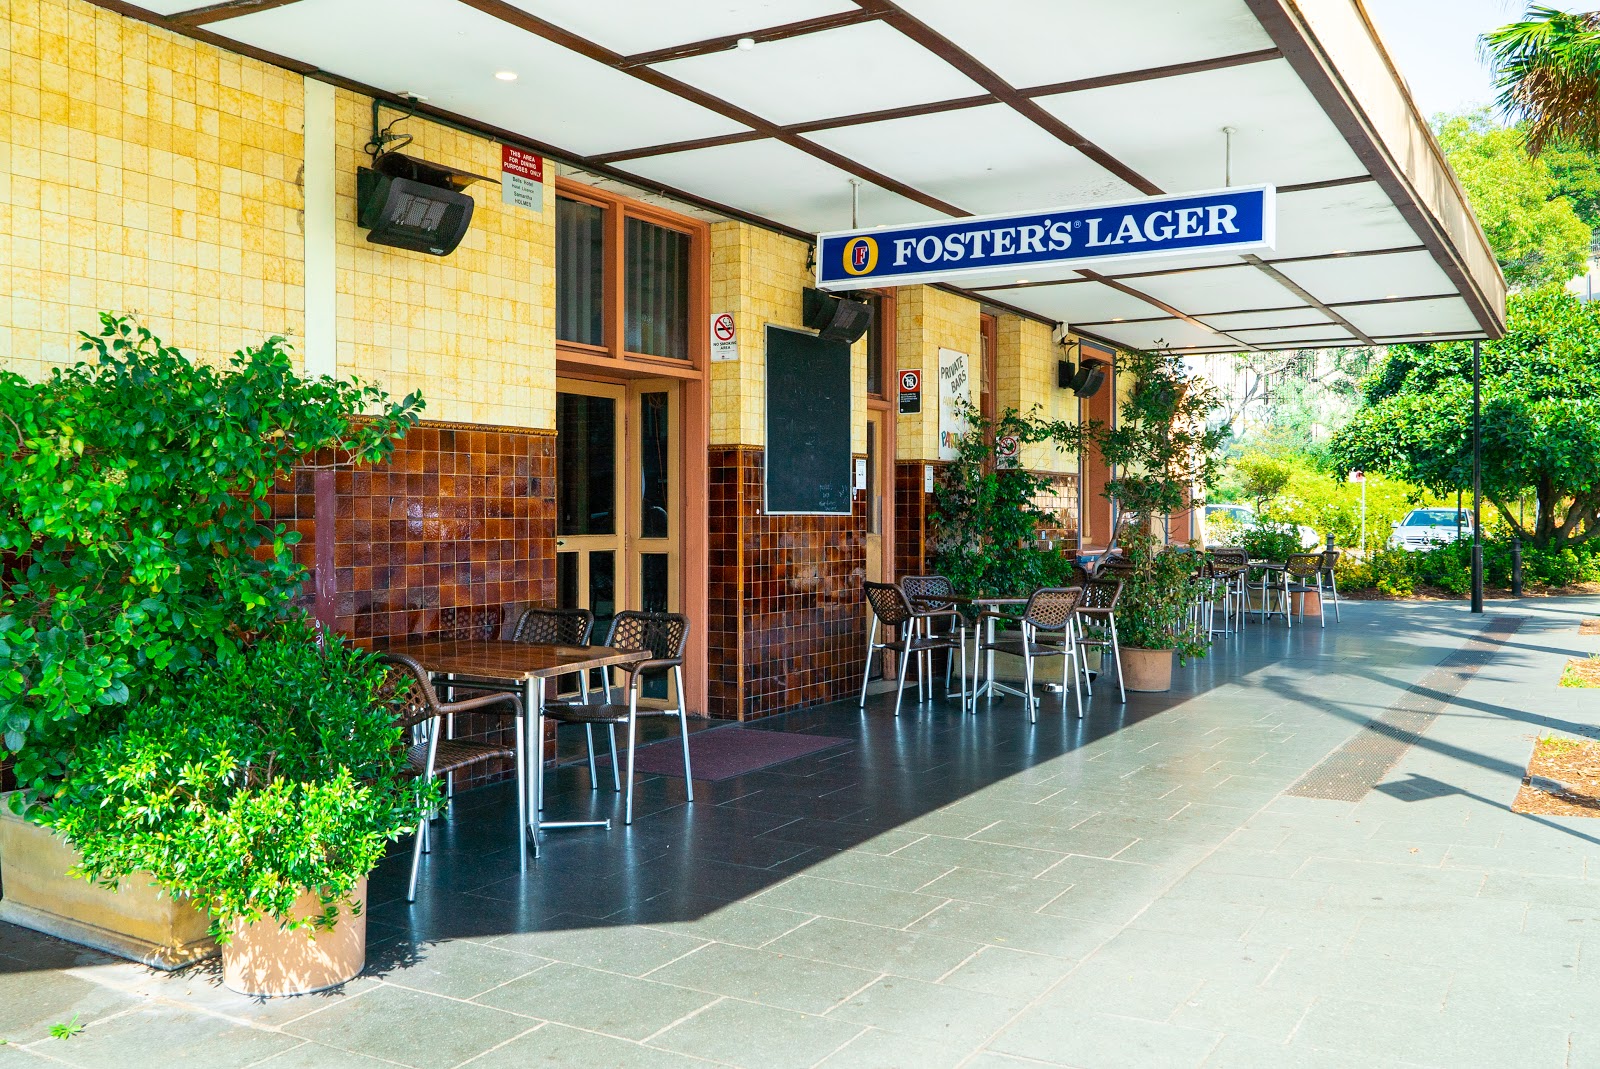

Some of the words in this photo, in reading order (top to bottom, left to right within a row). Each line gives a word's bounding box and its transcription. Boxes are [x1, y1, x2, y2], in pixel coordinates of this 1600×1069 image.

[510, 150, 521, 158] THIS
[522, 154, 536, 162] AREA
[503, 162, 528, 173] PURPOSES
[520, 160, 537, 169] DINING
[515, 199, 532, 207] HOLMES
[892, 218, 1073, 267] FOSTER'S
[1084, 204, 1240, 247] LAGER
[941, 356, 963, 379] PRIVATE
[951, 370, 966, 393] BARS
